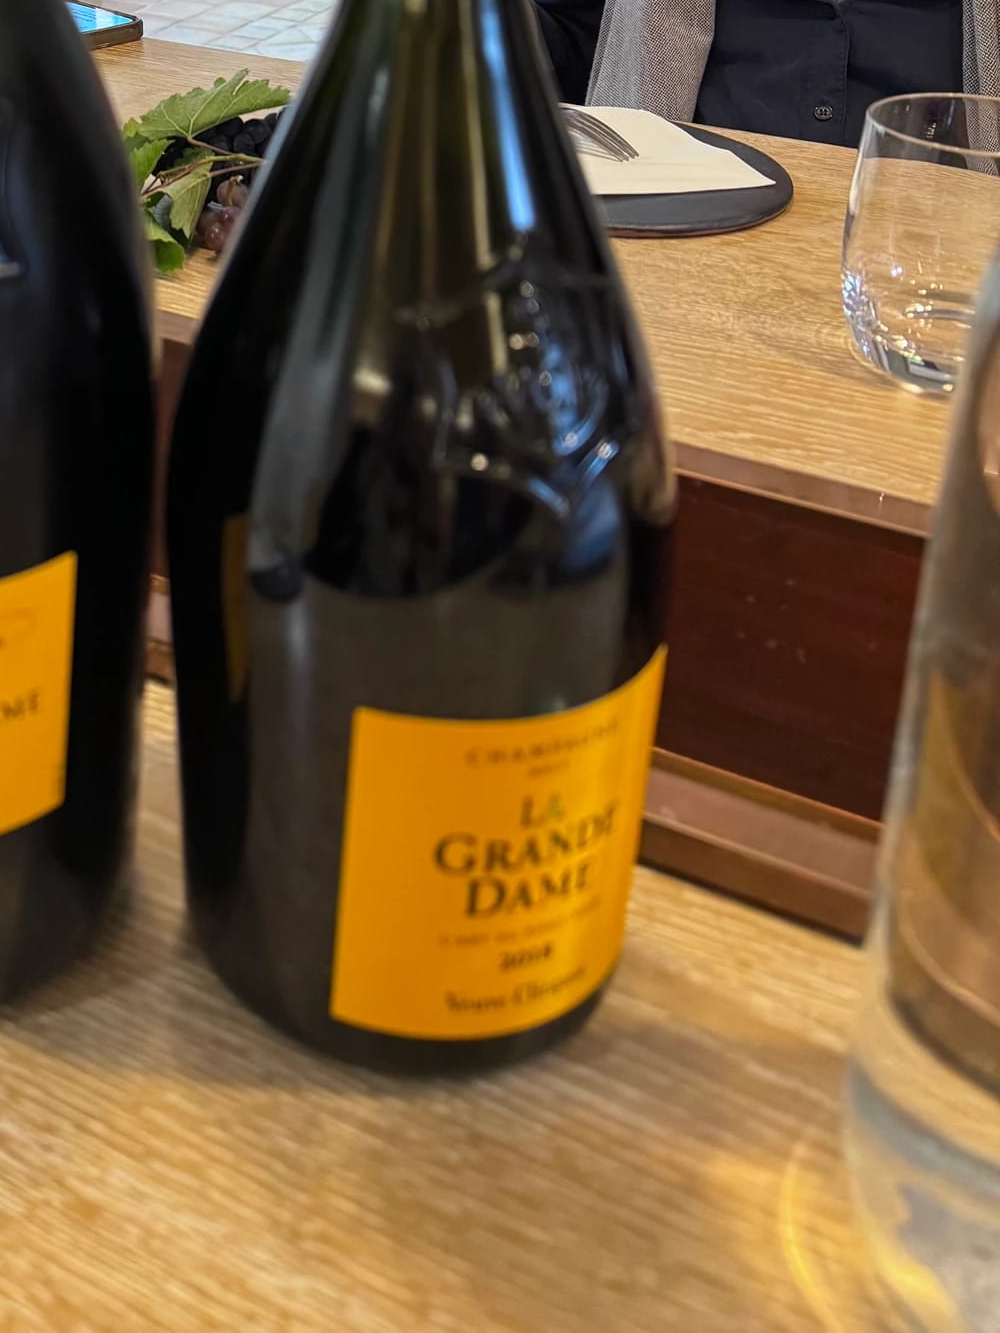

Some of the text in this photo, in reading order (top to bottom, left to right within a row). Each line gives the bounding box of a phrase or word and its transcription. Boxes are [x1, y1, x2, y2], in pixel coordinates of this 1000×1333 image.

[432, 798, 621, 878] GRANDE
[519, 793, 567, 831] LA
[463, 861, 596, 919] DAME
